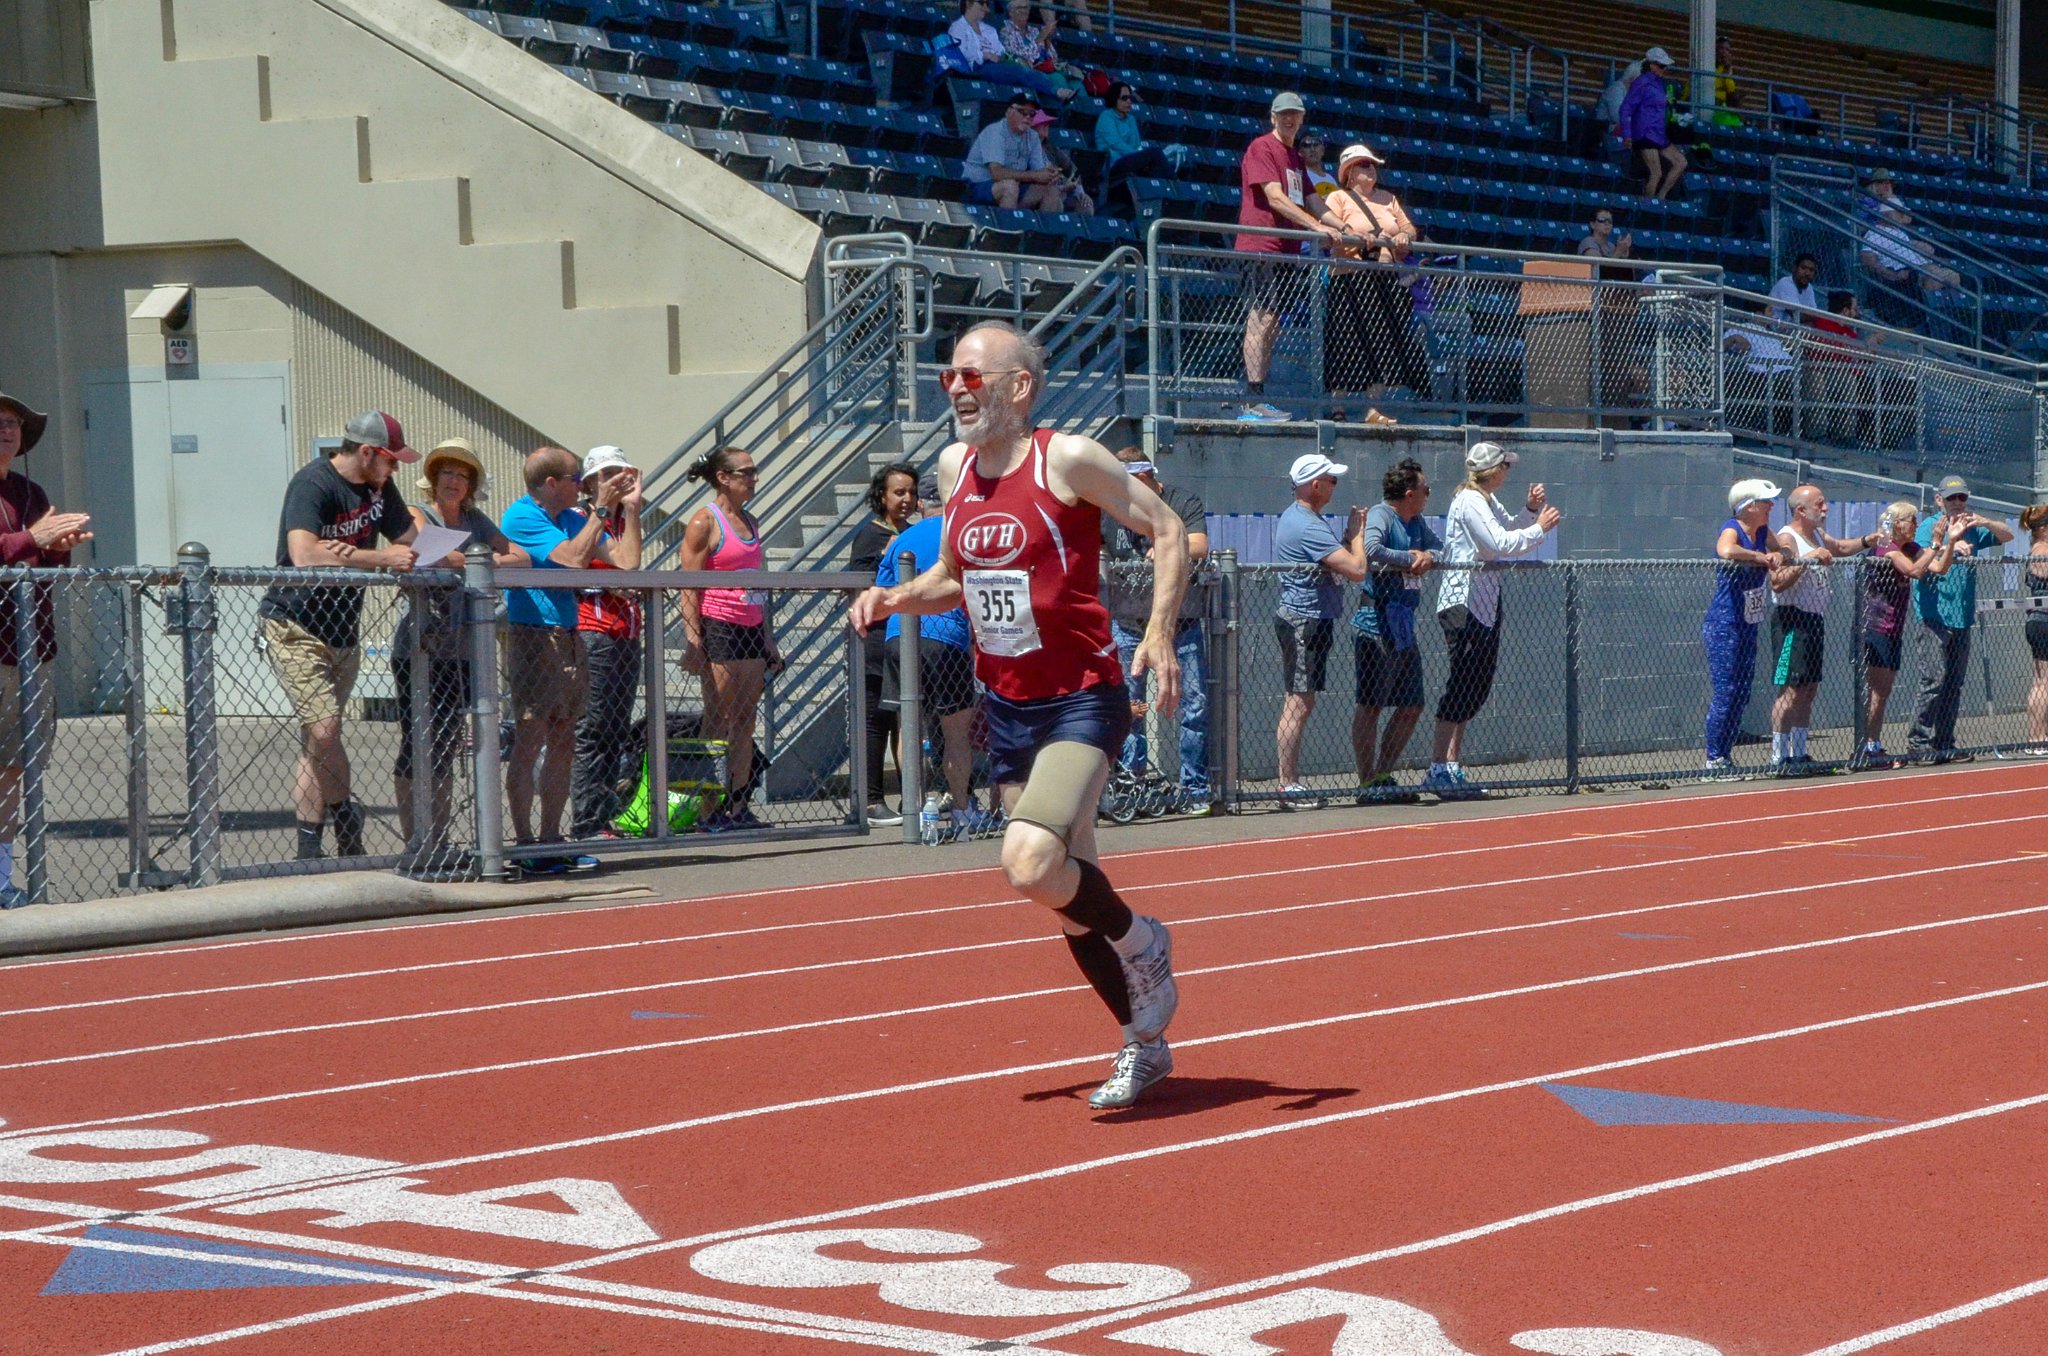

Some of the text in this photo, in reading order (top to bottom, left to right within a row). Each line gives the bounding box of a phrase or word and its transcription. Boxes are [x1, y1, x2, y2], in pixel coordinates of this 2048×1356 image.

[170, 340, 188, 348] AED
[320, 499, 384, 538] WASHIGON
[963, 523, 1018, 551] GVH
[967, 575, 1022, 587] Washington State
[978, 590, 1016, 623] 355
[1000, 626, 1024, 635] Games
[208, 1176, 662, 1249] 4
[689, 1228, 1191, 1317] 3
